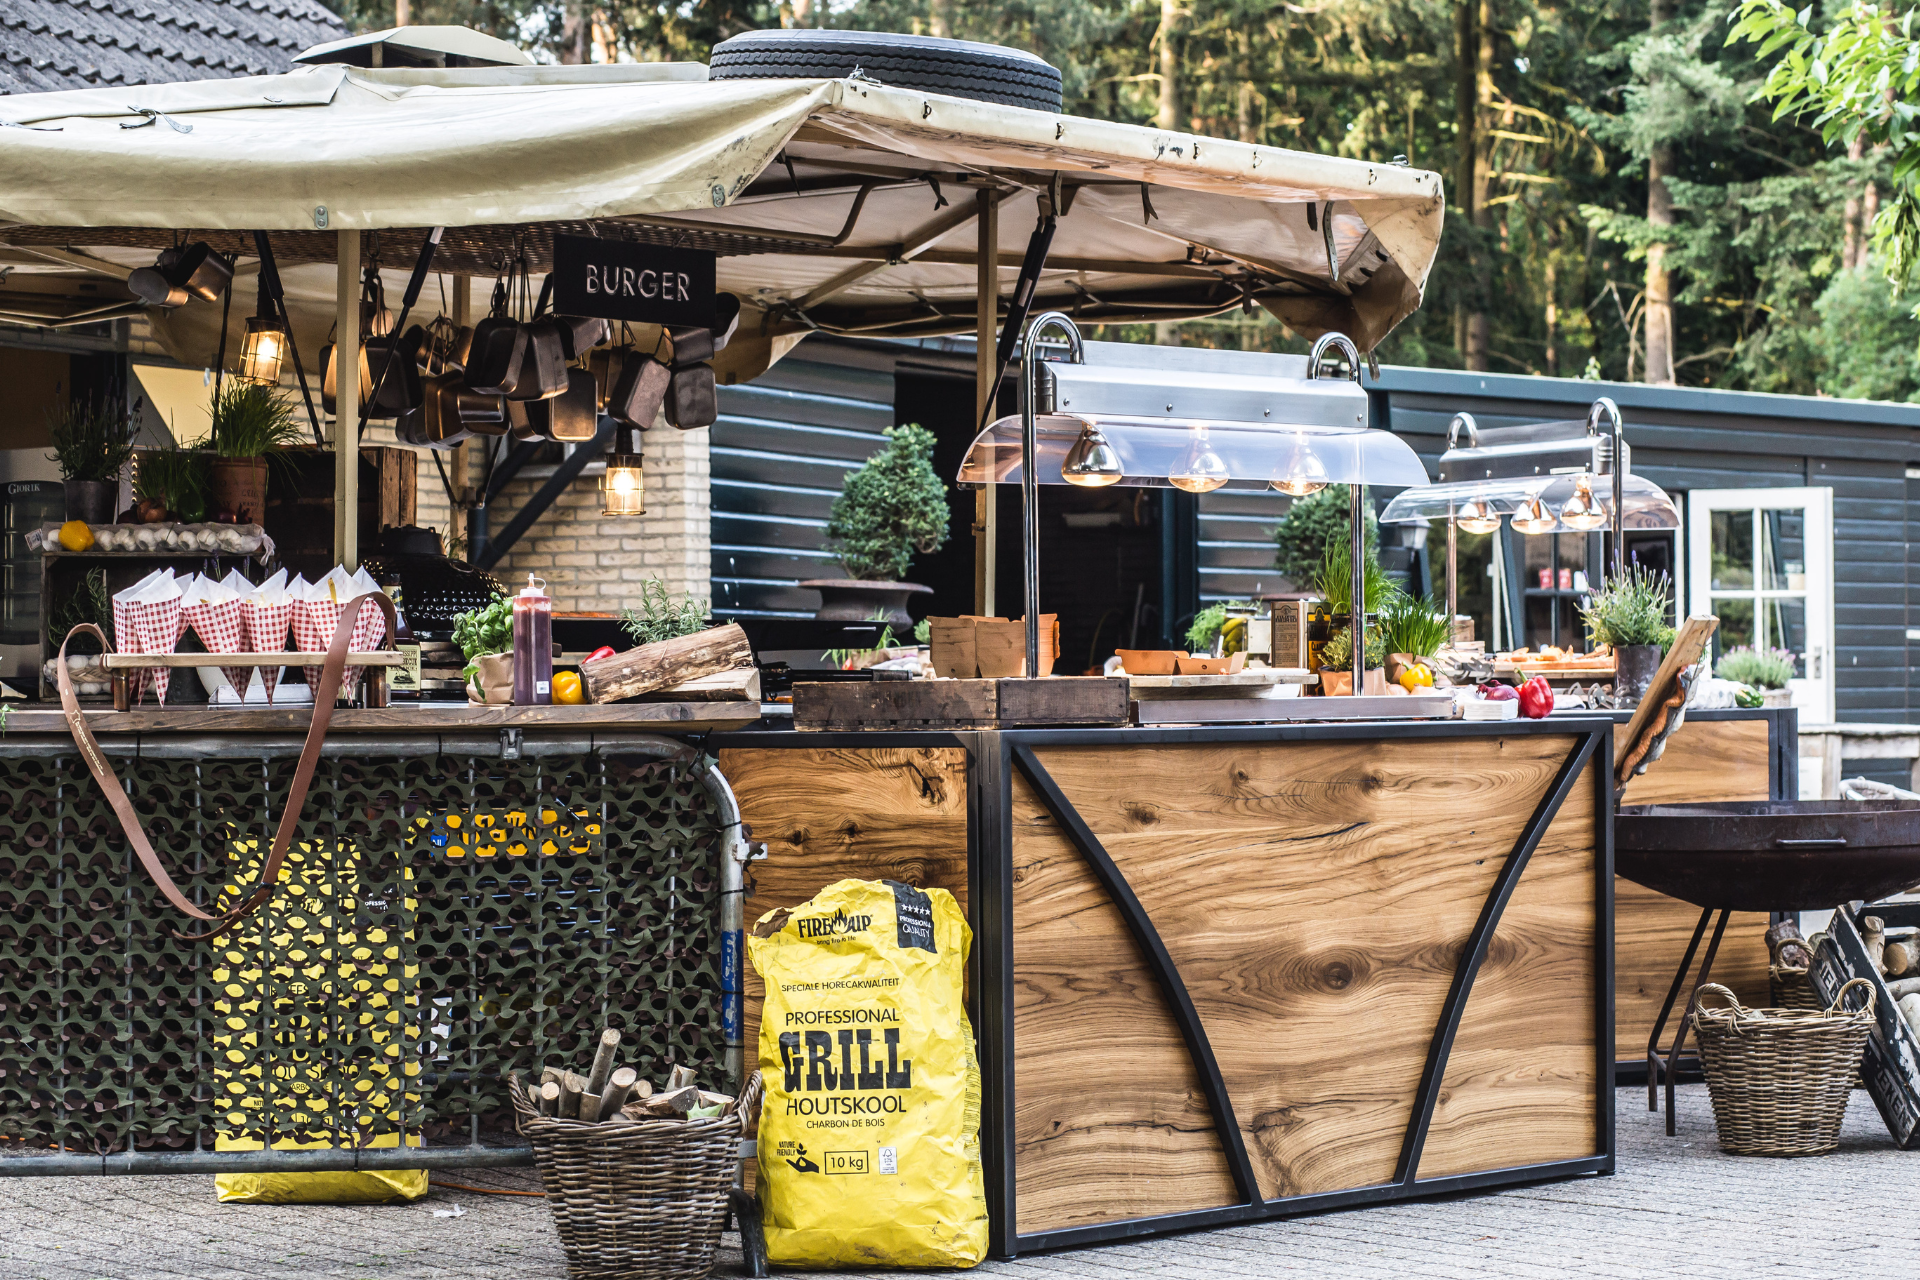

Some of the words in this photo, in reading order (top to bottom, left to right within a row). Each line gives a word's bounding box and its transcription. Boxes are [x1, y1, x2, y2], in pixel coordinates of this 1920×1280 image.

[586, 264, 690, 301] BURGER
[7, 483, 41, 495] GIORIK
[797, 918, 836, 938] FIRE
[902, 923, 930, 938] QUALITY
[781, 983, 820, 992] SPECIALE
[822, 978, 900, 990] HORECAKWALITEIT
[786, 1008, 900, 1026] PROFESSIONAL
[778, 1028, 911, 1093] GRILL
[786, 1095, 907, 1116] HOUTSKOOL
[806, 1120, 850, 1129] CHARBON
[851, 1119, 863, 1128] DE
[865, 1118, 885, 1127] BOIS
[830, 1157, 845, 1169] 10
[849, 1156, 864, 1170] kg
